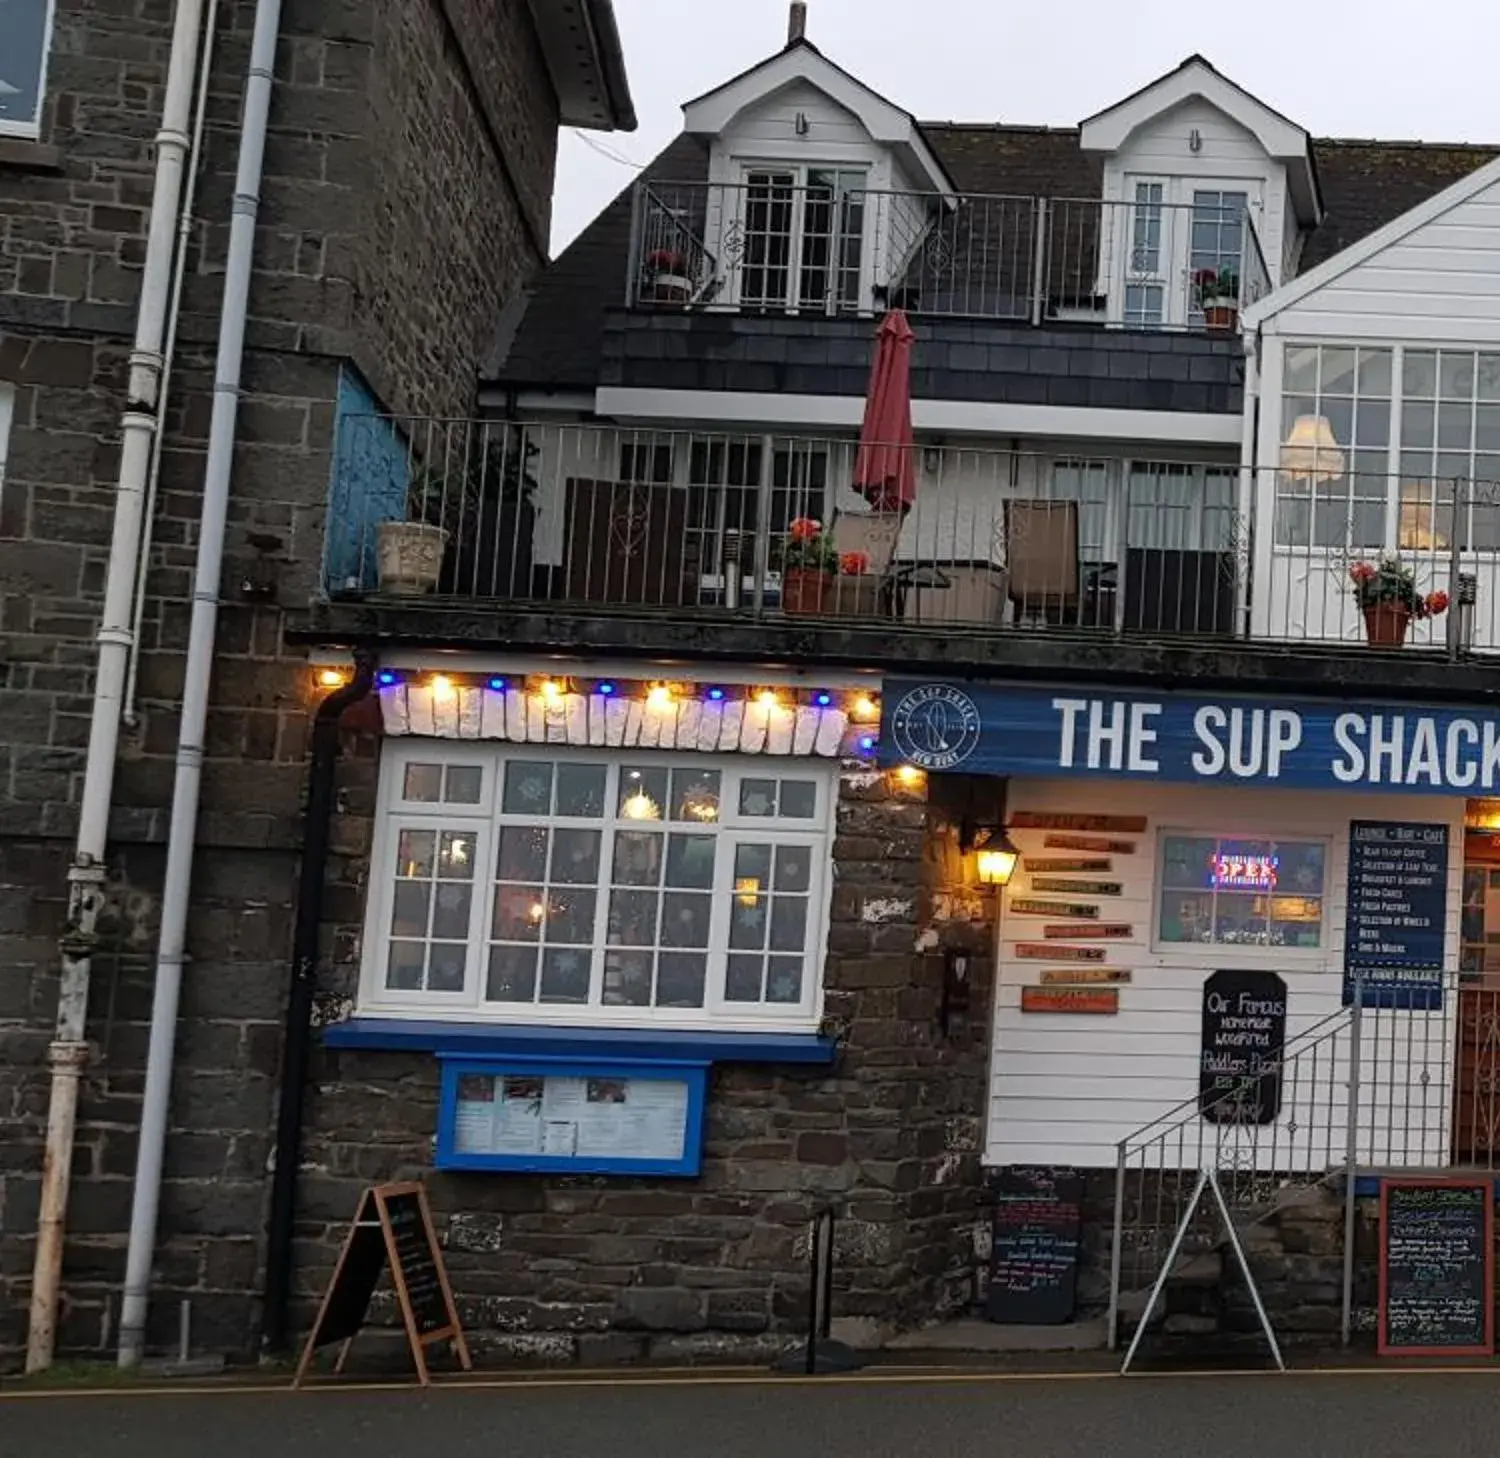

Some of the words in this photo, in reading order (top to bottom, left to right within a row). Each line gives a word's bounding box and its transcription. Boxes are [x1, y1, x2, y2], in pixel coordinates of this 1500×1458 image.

[1052, 698, 1160, 772] THE
[1192, 705, 1301, 777] SUP
[1216, 863, 1276, 878] OPEN
